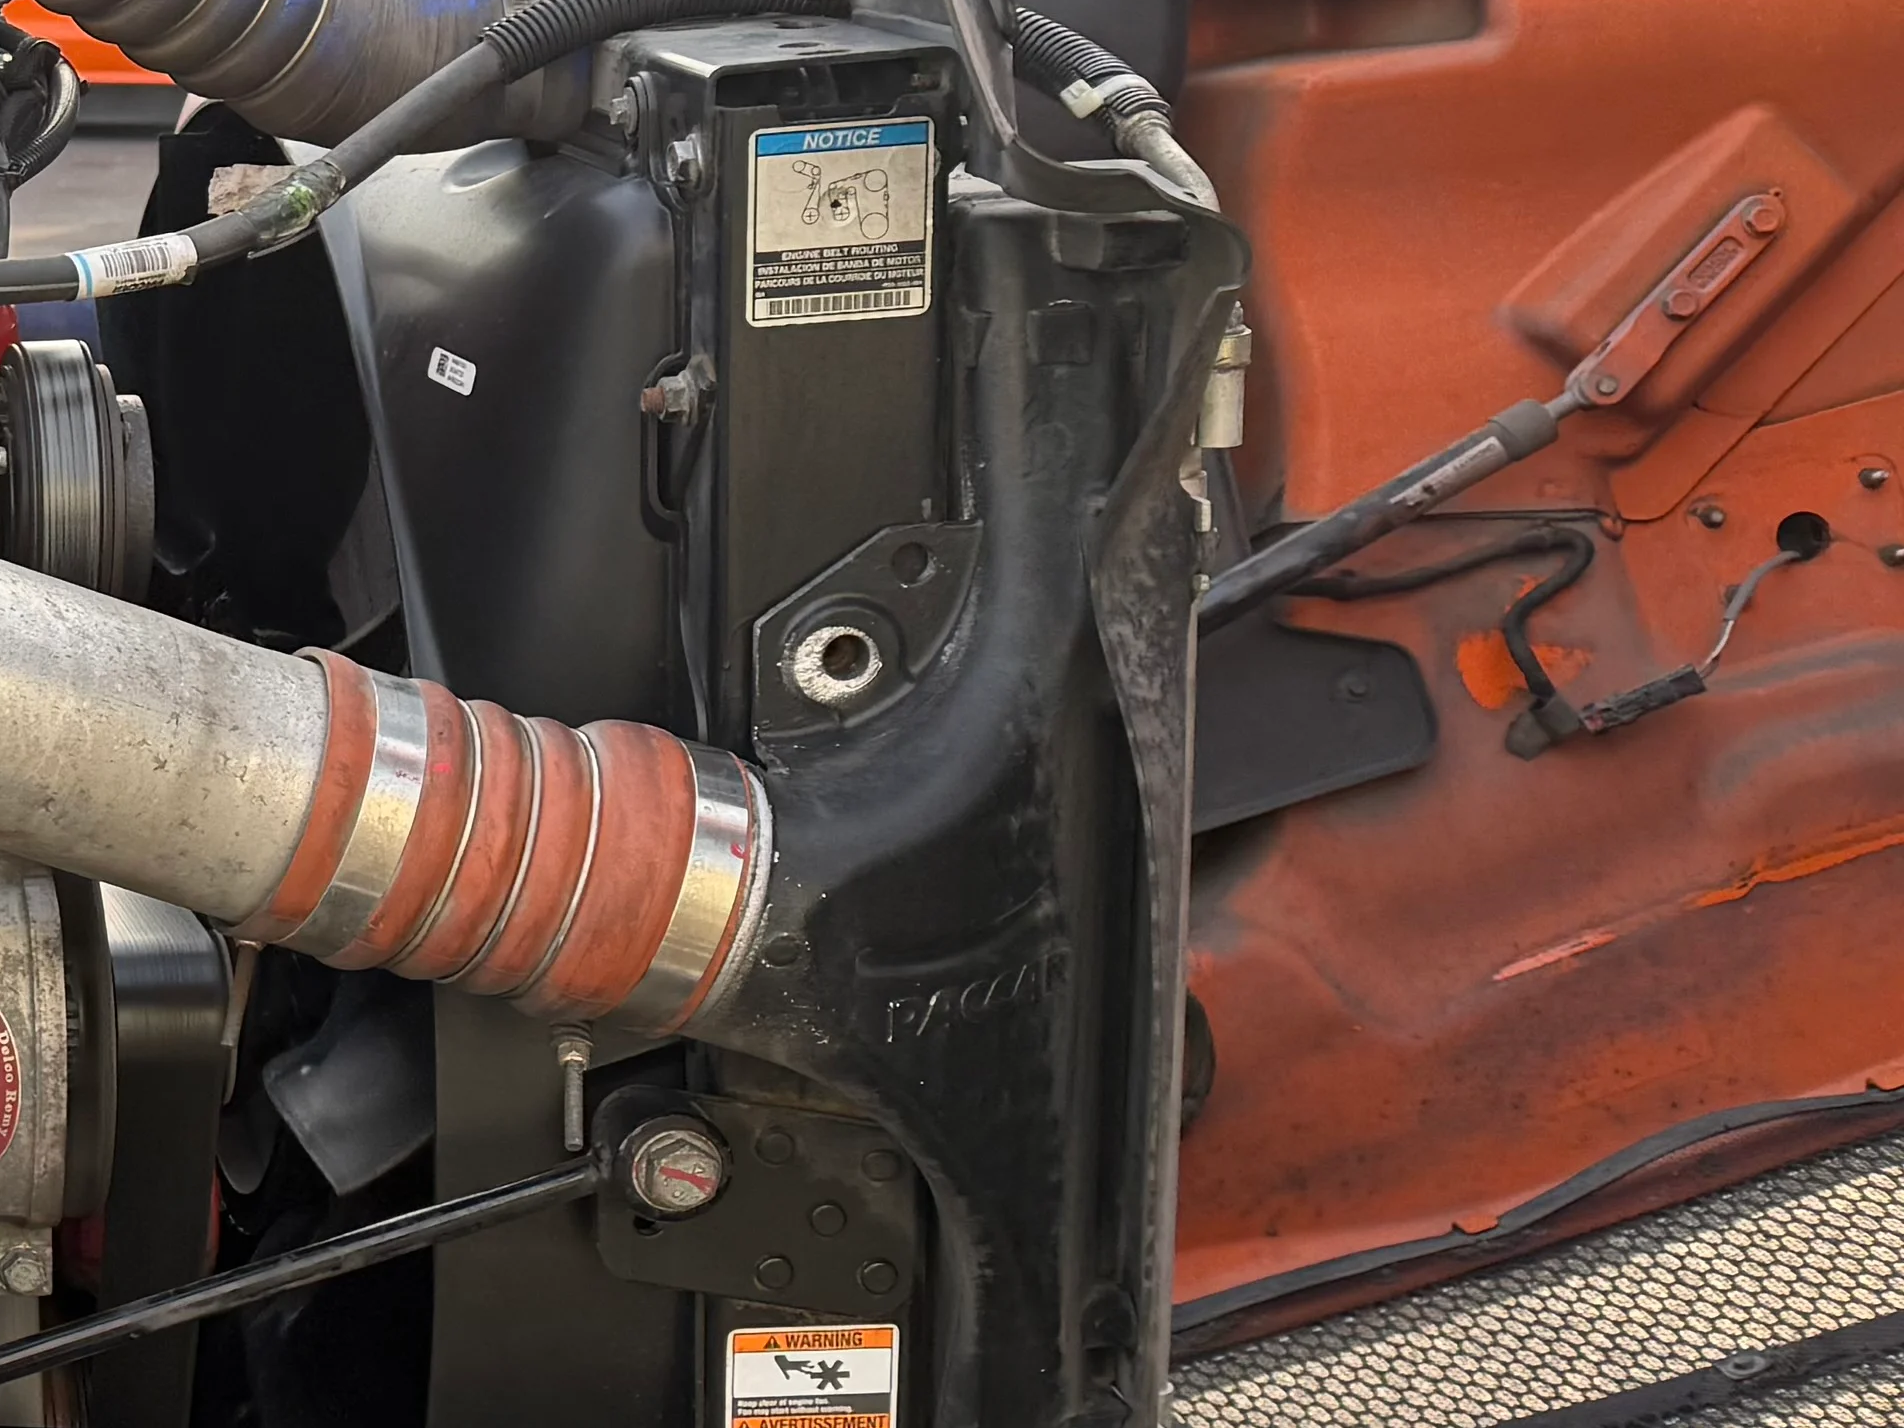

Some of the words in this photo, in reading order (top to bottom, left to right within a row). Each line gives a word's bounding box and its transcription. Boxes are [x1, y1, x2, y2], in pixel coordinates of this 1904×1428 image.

[803, 128, 882, 150] NOTICE
[781, 250, 820, 261] ENGINE
[823, 247, 848, 257] BELT
[851, 244, 898, 255] ROUTING
[758, 264, 820, 276] INSTALACION
[822, 262, 835, 271] DE
[837, 259, 869, 270] BANDA
[871, 257, 884, 267] DE
[886, 255, 921, 265] MOTOR
[754, 277, 801, 289] PARCOURS
[803, 276, 814, 285] DE
[816, 274, 827, 284] LA
[785, 1332, 863, 1348] WARNING
